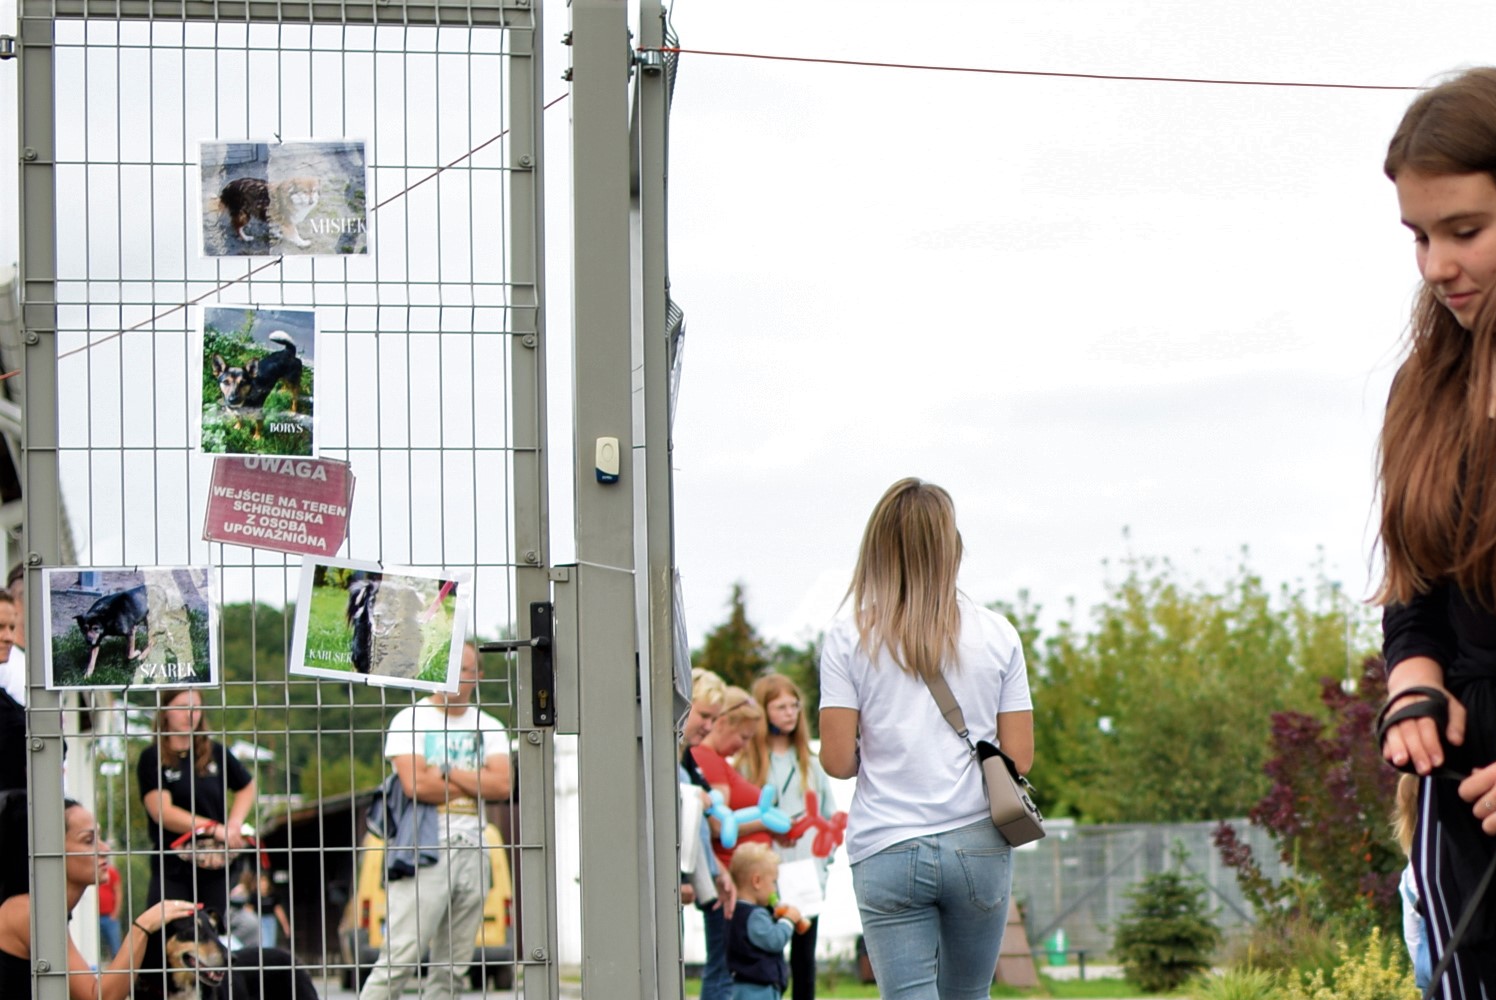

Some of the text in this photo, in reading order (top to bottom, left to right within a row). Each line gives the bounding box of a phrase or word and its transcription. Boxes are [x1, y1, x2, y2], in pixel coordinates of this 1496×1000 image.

[310, 218, 367, 233] MISIEK
[270, 422, 304, 433] BORYS
[244, 457, 327, 482] UWAGA
[213, 486, 347, 518] WEJŚCIE NA TEREN
[233, 501, 324, 525] SCHRONISKA
[246, 514, 307, 535] Z OSOBĄ
[223, 521, 327, 551] UPOWAŻNIONĄ
[140, 661, 197, 679] SZAREK
